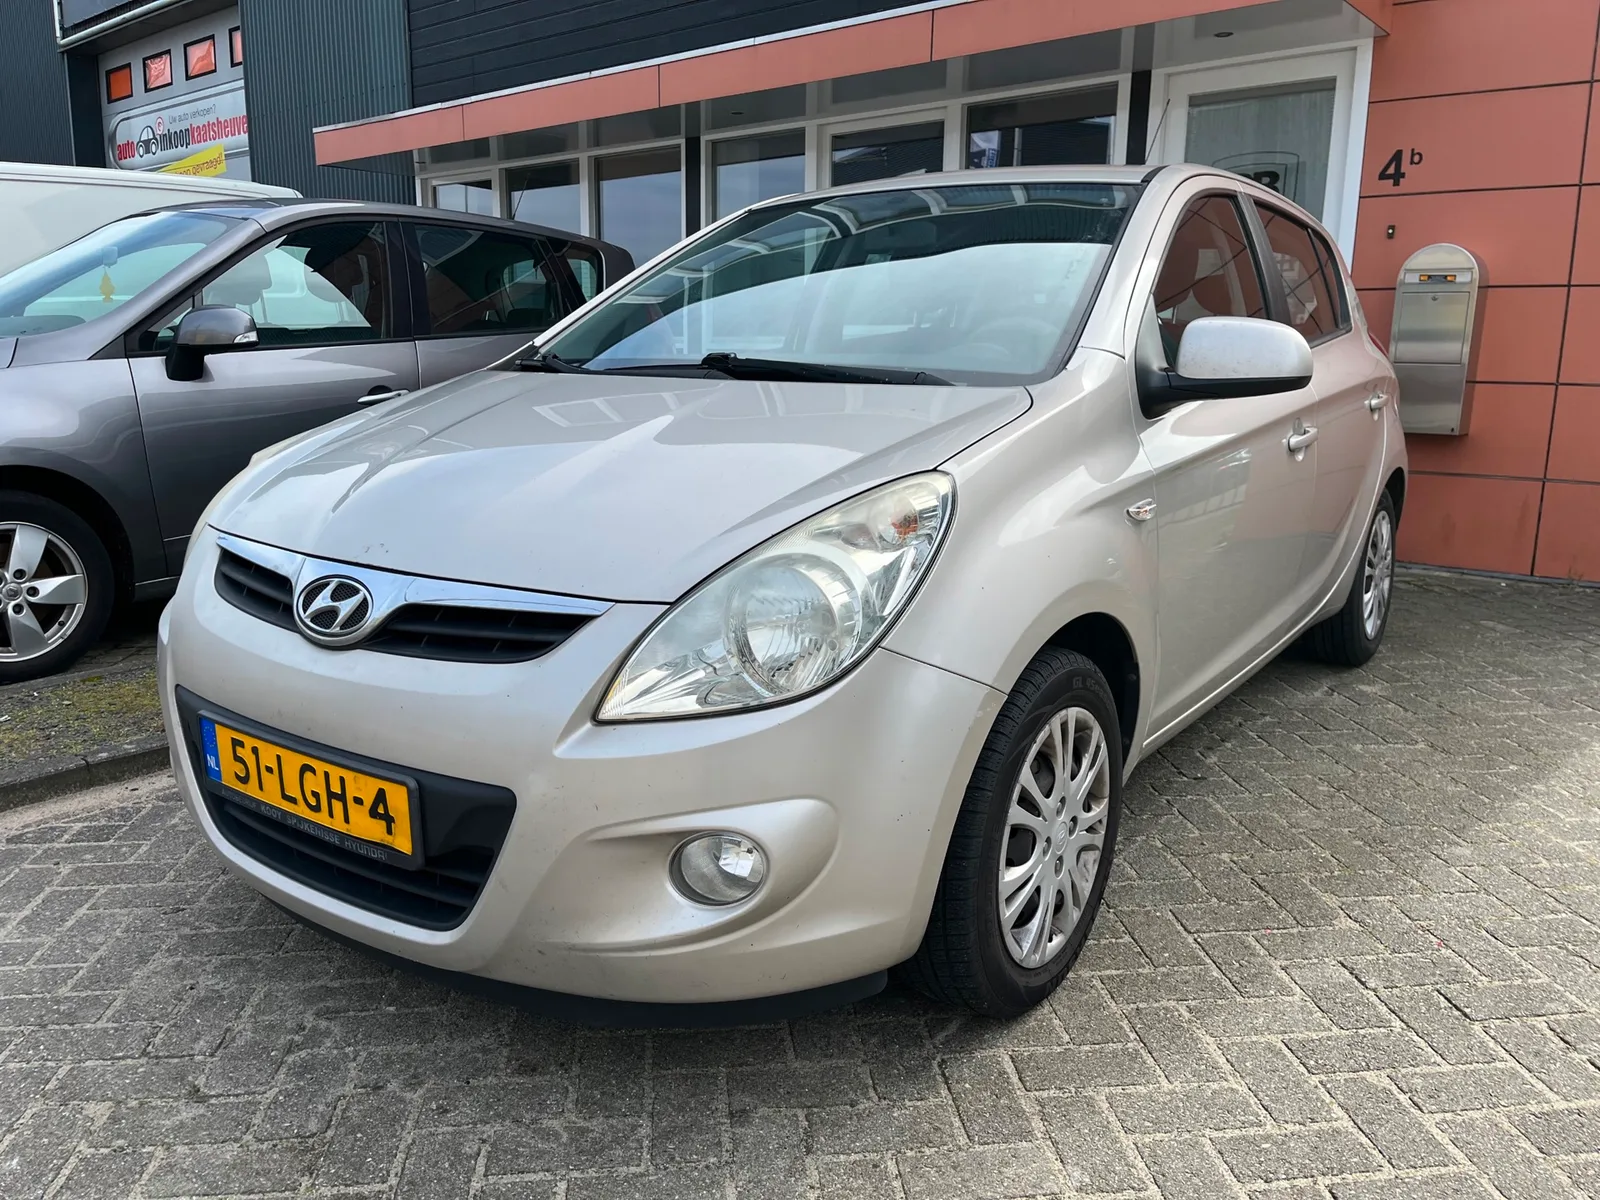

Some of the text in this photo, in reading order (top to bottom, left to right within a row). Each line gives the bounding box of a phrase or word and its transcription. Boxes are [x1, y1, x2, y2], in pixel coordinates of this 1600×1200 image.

[168, 103, 217, 125] Uw auto verkopen?
[116, 140, 136, 161] auto
[206, 753, 219, 771] NL
[231, 736, 396, 836] 51-LGH-4
[260, 804, 282, 820] KOOY
[286, 814, 341, 845] SPIJKENISSE
[344, 838, 388, 861] HYUNDAI
